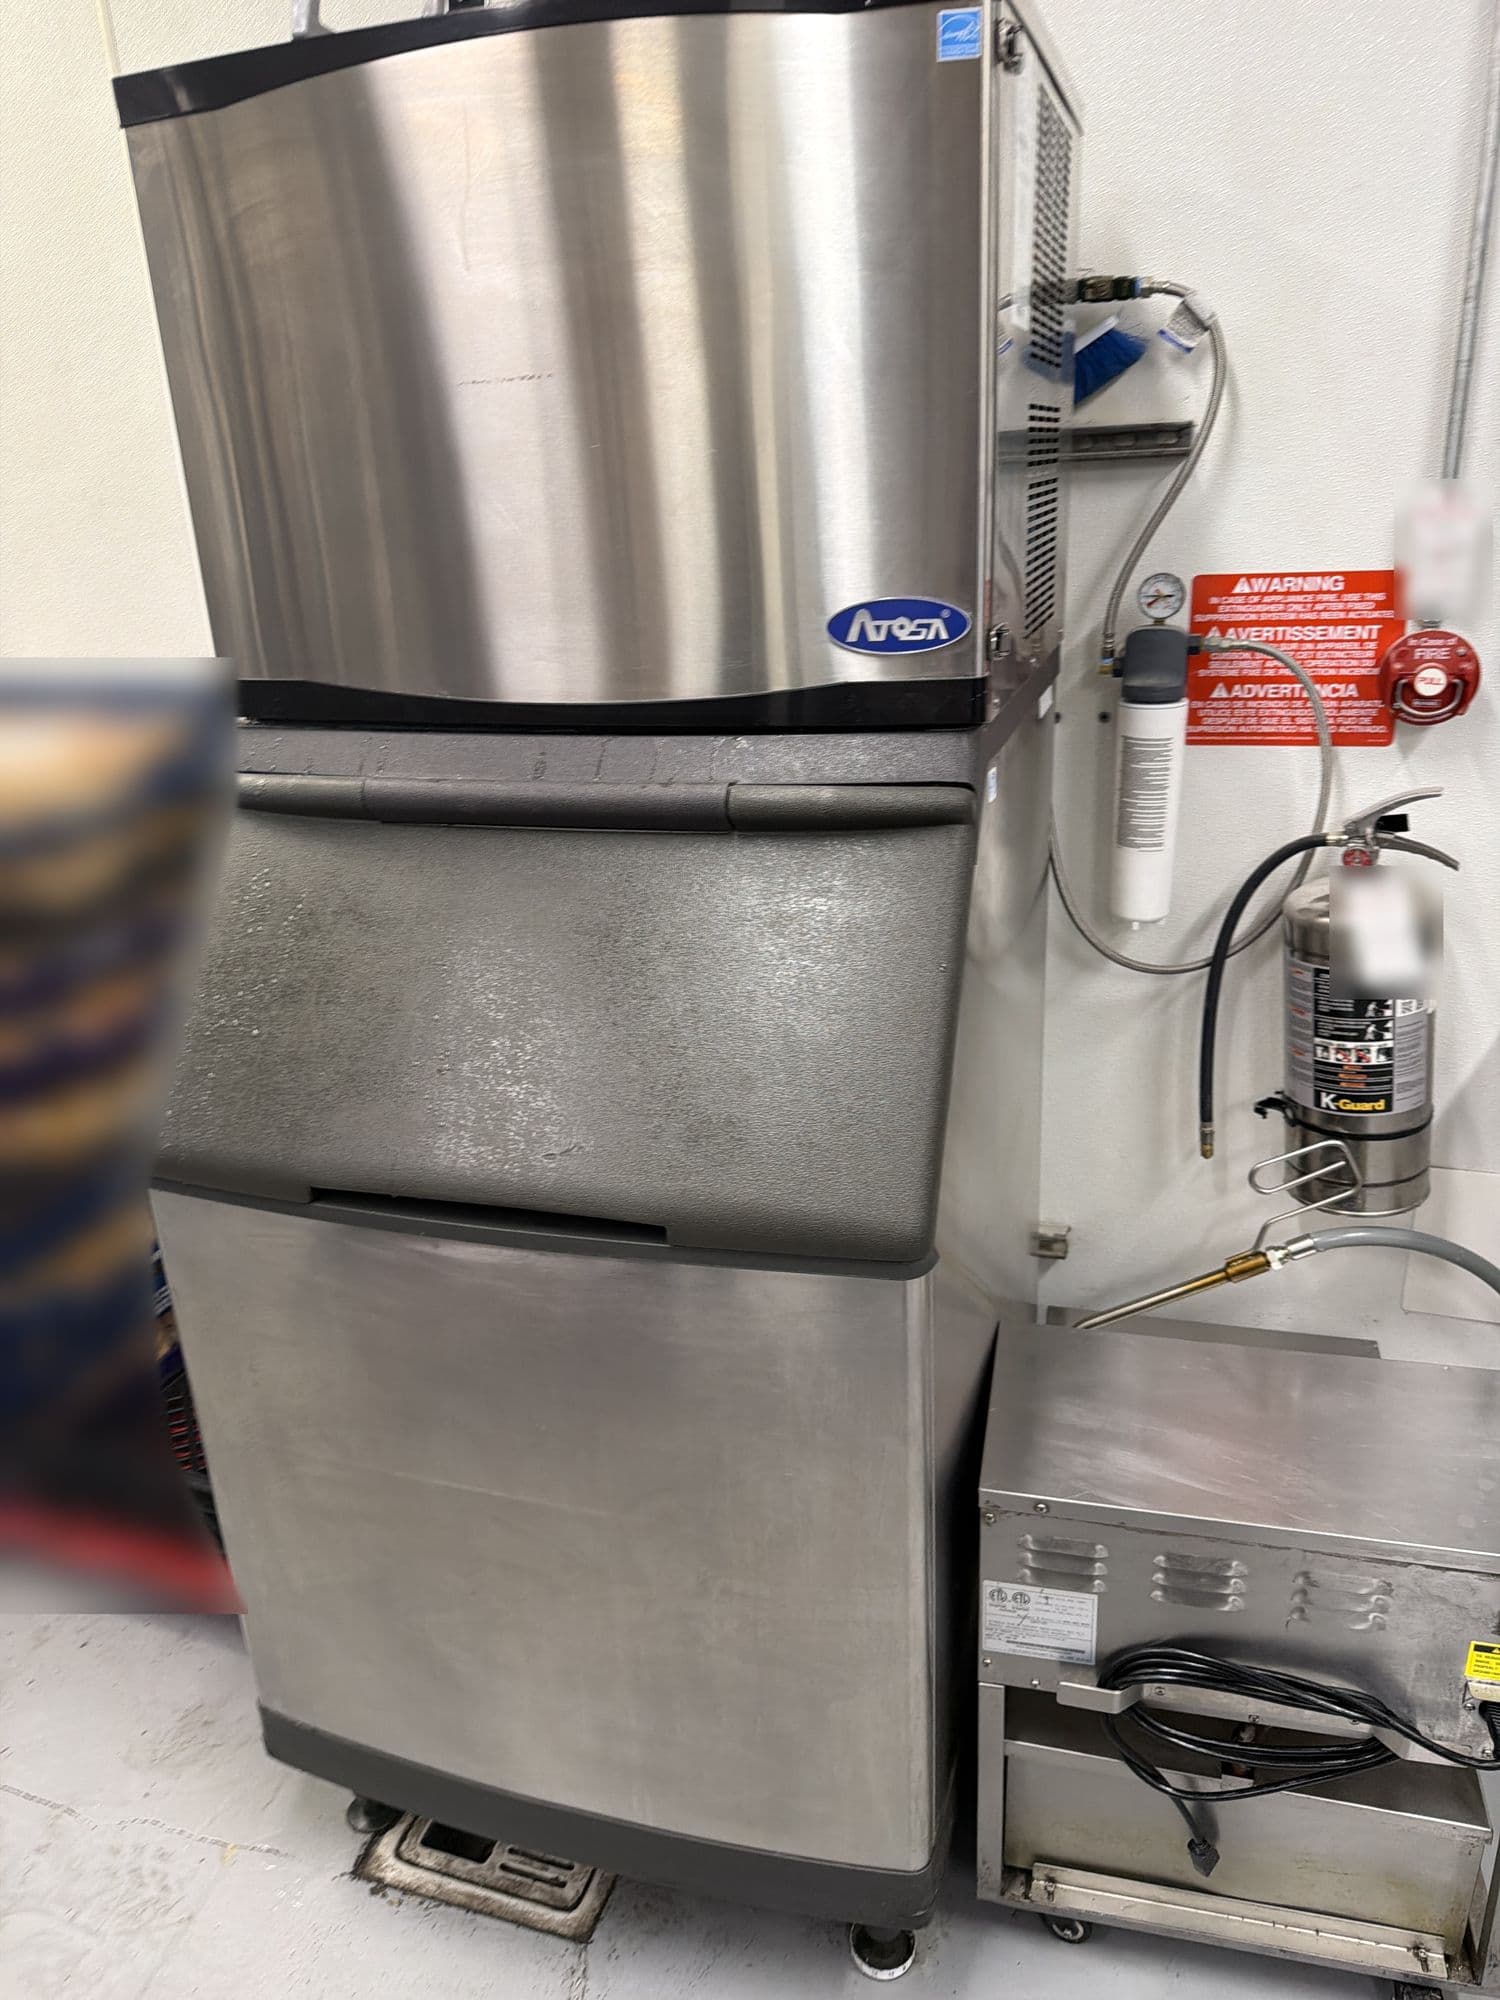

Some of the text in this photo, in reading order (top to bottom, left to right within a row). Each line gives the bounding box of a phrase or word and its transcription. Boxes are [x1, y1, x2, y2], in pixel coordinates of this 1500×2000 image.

[1250, 576, 1345, 592] WARNING
[1224, 625, 1382, 641] AVERTISSEMENT
[1413, 647, 1452, 660] FIRE
[1320, 1092, 1386, 1111] K-Guard
